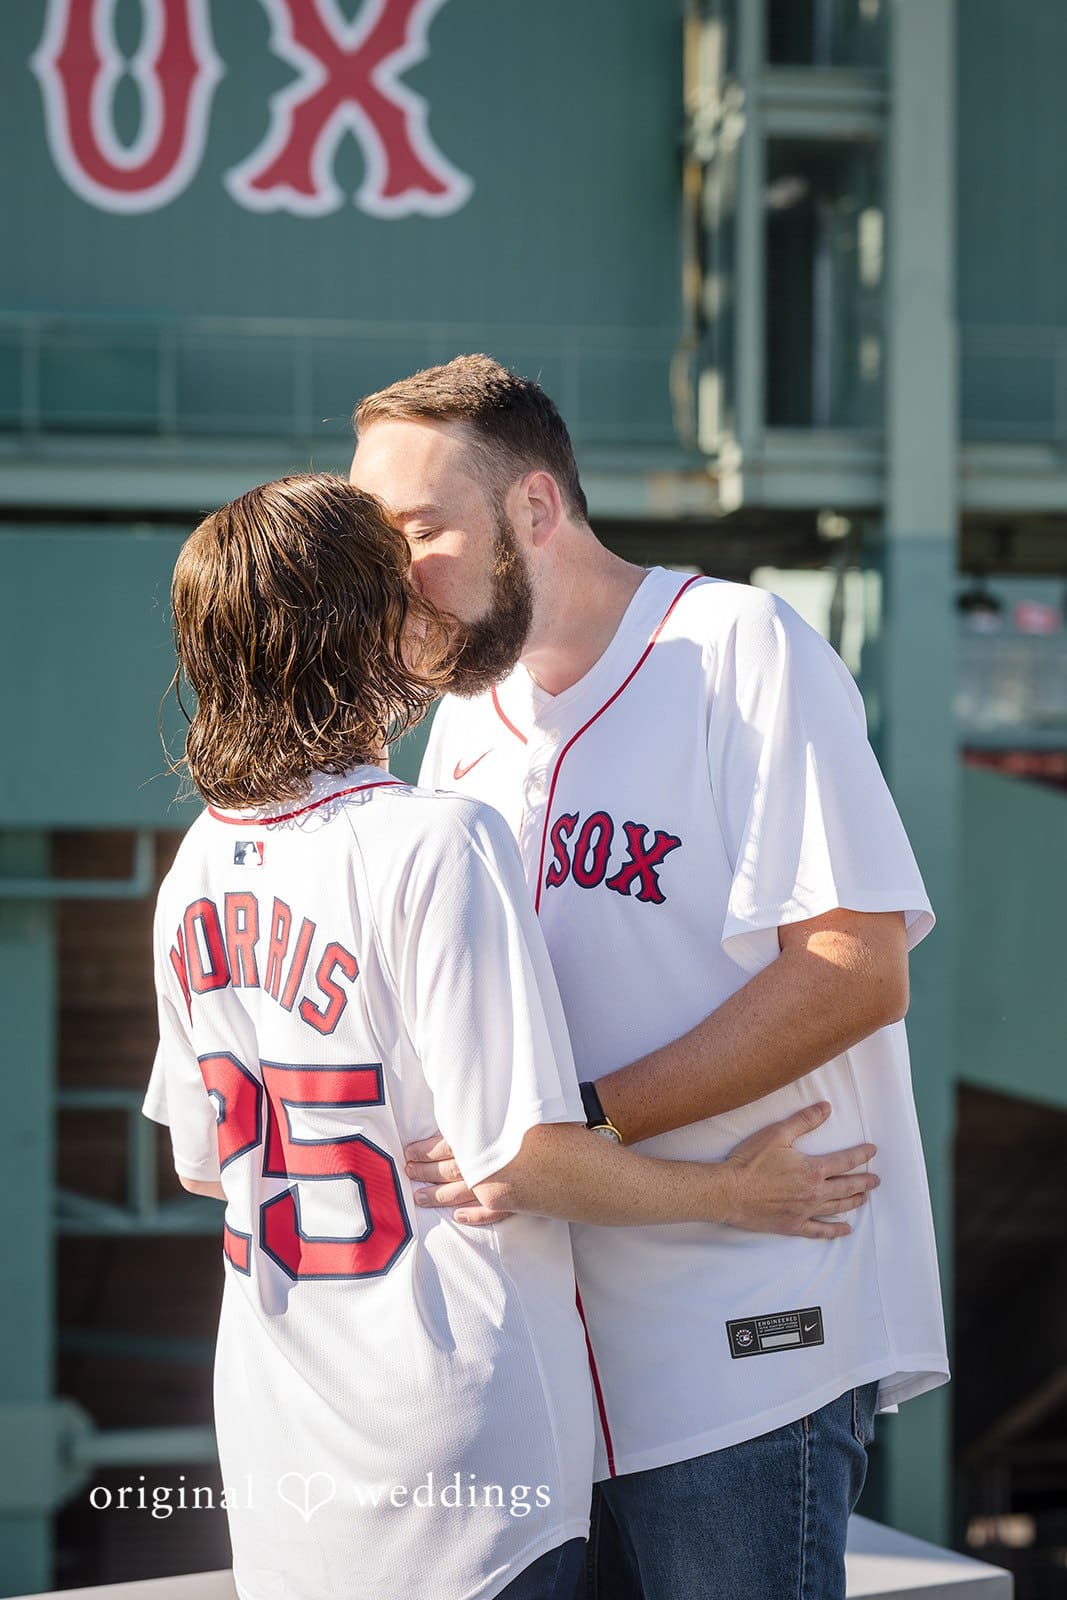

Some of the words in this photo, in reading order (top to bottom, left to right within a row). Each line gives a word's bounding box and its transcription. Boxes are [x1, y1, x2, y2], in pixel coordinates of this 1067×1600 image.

[30, 0, 476, 219] OX
[545, 810, 682, 905] SOX
[197, 1051, 414, 1282] 25
[757, 1315, 798, 1327] ENGINEERED
